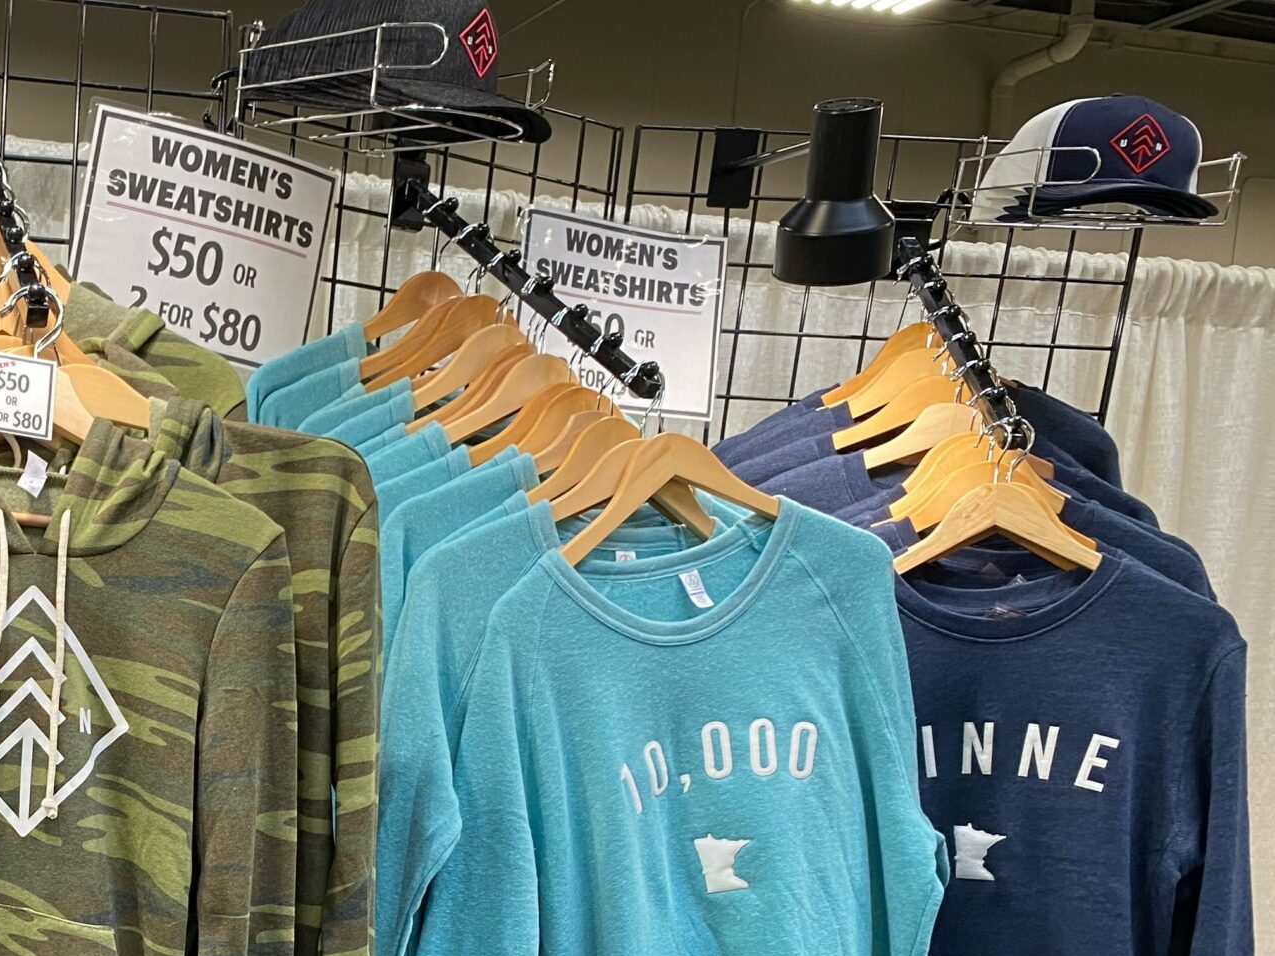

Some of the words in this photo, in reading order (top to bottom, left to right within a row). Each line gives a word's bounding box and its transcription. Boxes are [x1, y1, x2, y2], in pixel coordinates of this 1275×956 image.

[151, 135, 293, 200] WOMEN'S
[106, 168, 314, 249] SWEATSHIRTS
[147, 226, 224, 286] $50
[233, 263, 257, 288] OR
[566, 227, 678, 271] WOMEN'S
[535, 257, 706, 307] SWEATSHIRTS
[158, 301, 194, 329] FOR
[199, 302, 262, 351] $80
[5, 395, 17, 406] OR
[13, 411, 42, 430] $80
[79, 707, 92, 735] N
[620, 718, 818, 815] 10,000
